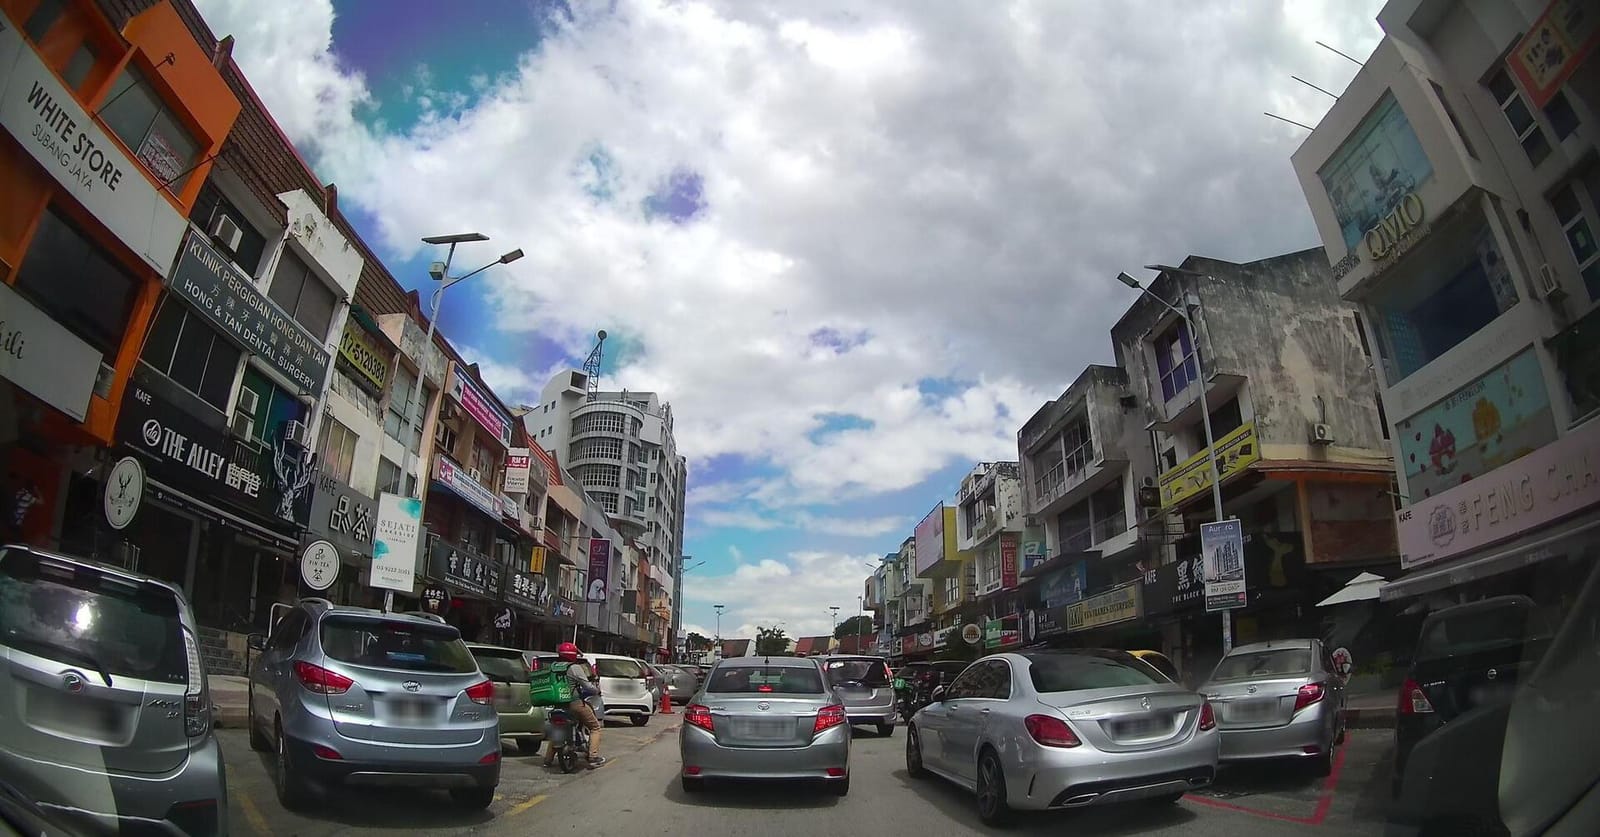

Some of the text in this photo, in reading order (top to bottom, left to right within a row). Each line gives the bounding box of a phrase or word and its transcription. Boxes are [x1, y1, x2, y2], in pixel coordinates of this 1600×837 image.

[28, 80, 122, 192] WHITE STORE
[32, 124, 93, 192] SUBANG JAYA
[190, 241, 224, 277] KLINIK
[222, 271, 271, 320] PERGIGIAN
[270, 312, 294, 340] HONG
[311, 345, 327, 367] TAN
[0, 320, 24, 360] ili
[184, 279, 315, 389] HONG & TAN DENTAL SURGERY
[135, 388, 152, 405] KAFE
[162, 427, 188, 462] THE
[186, 442, 225, 480] ALLEY
[319, 474, 337, 496] KAFE
[1472, 473, 1534, 531] FENG
